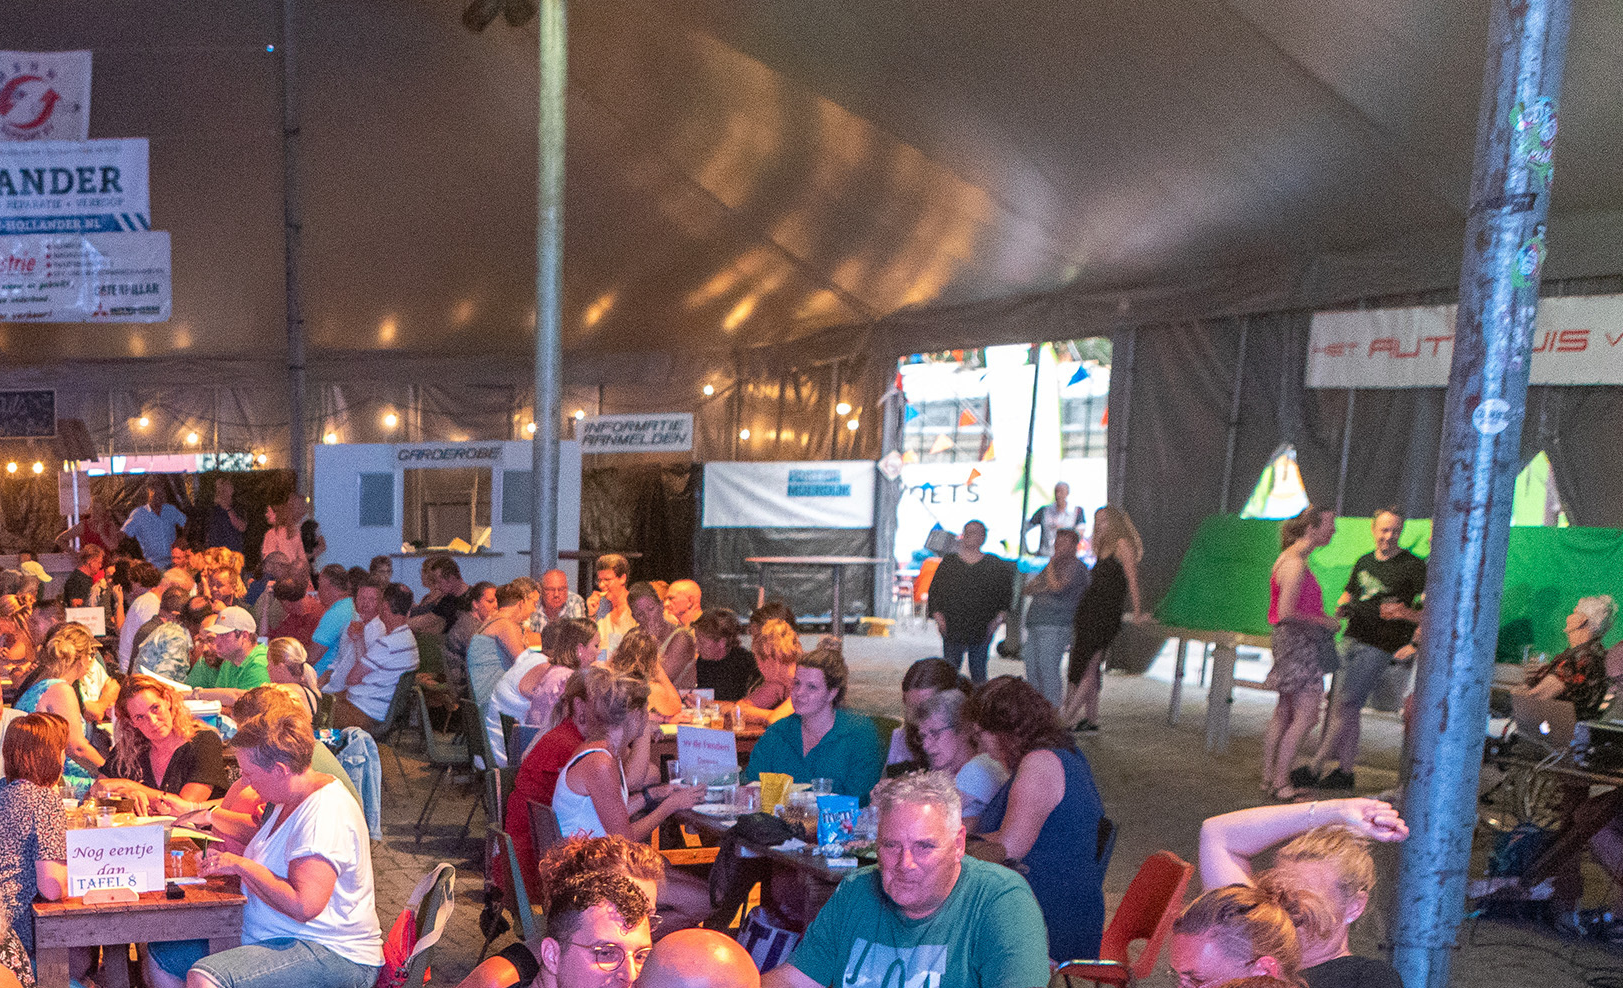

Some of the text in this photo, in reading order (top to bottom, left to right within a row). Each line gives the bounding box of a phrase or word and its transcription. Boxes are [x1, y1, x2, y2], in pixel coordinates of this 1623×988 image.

[583, 418, 686, 434] INFORMATIE
[581, 430, 689, 447] AANMELDEN
[397, 446, 503, 462] GARDEROBE
[72, 843, 154, 862] Nog eentje
[76, 874, 138, 891] TAFEL 8
